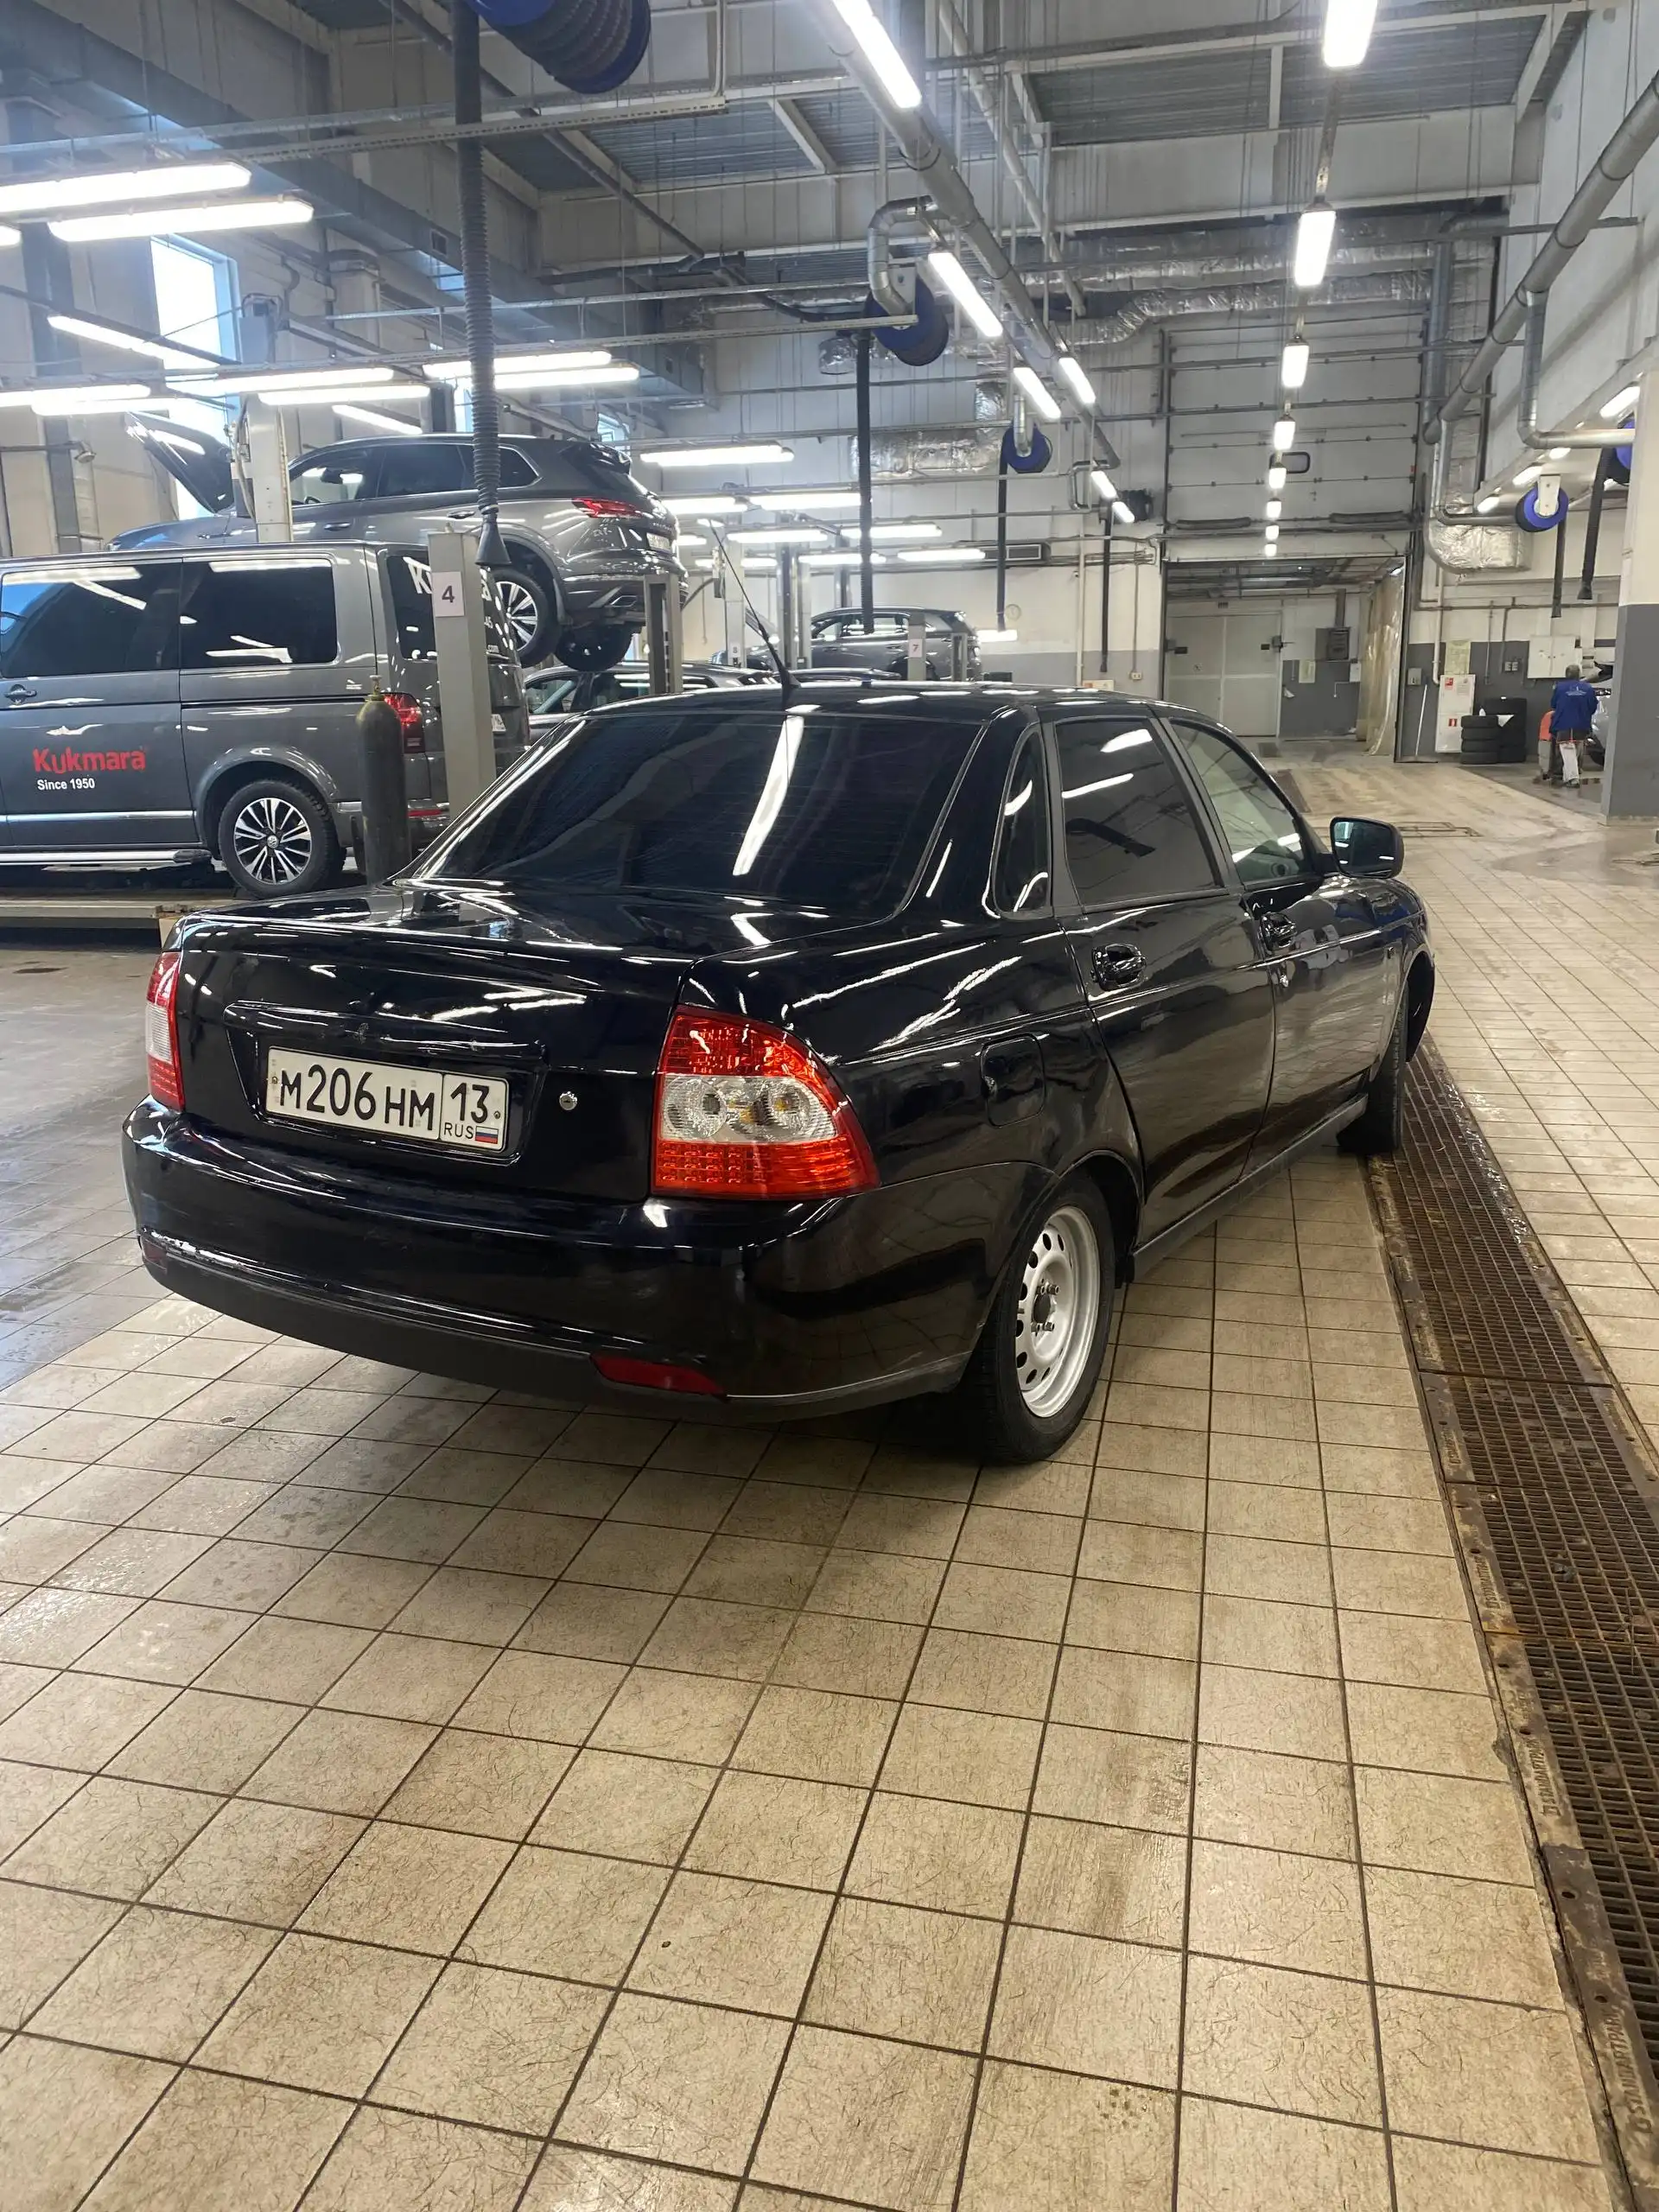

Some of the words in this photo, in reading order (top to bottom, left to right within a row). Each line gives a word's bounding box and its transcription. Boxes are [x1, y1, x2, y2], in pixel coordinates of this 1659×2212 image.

[441, 585, 455, 603] 4
[32, 746, 146, 774] Kukmara
[37, 779, 67, 791] Since
[69, 778, 95, 790] 1950
[450, 1082, 490, 1123] 13
[443, 1122, 474, 1139] RUS
